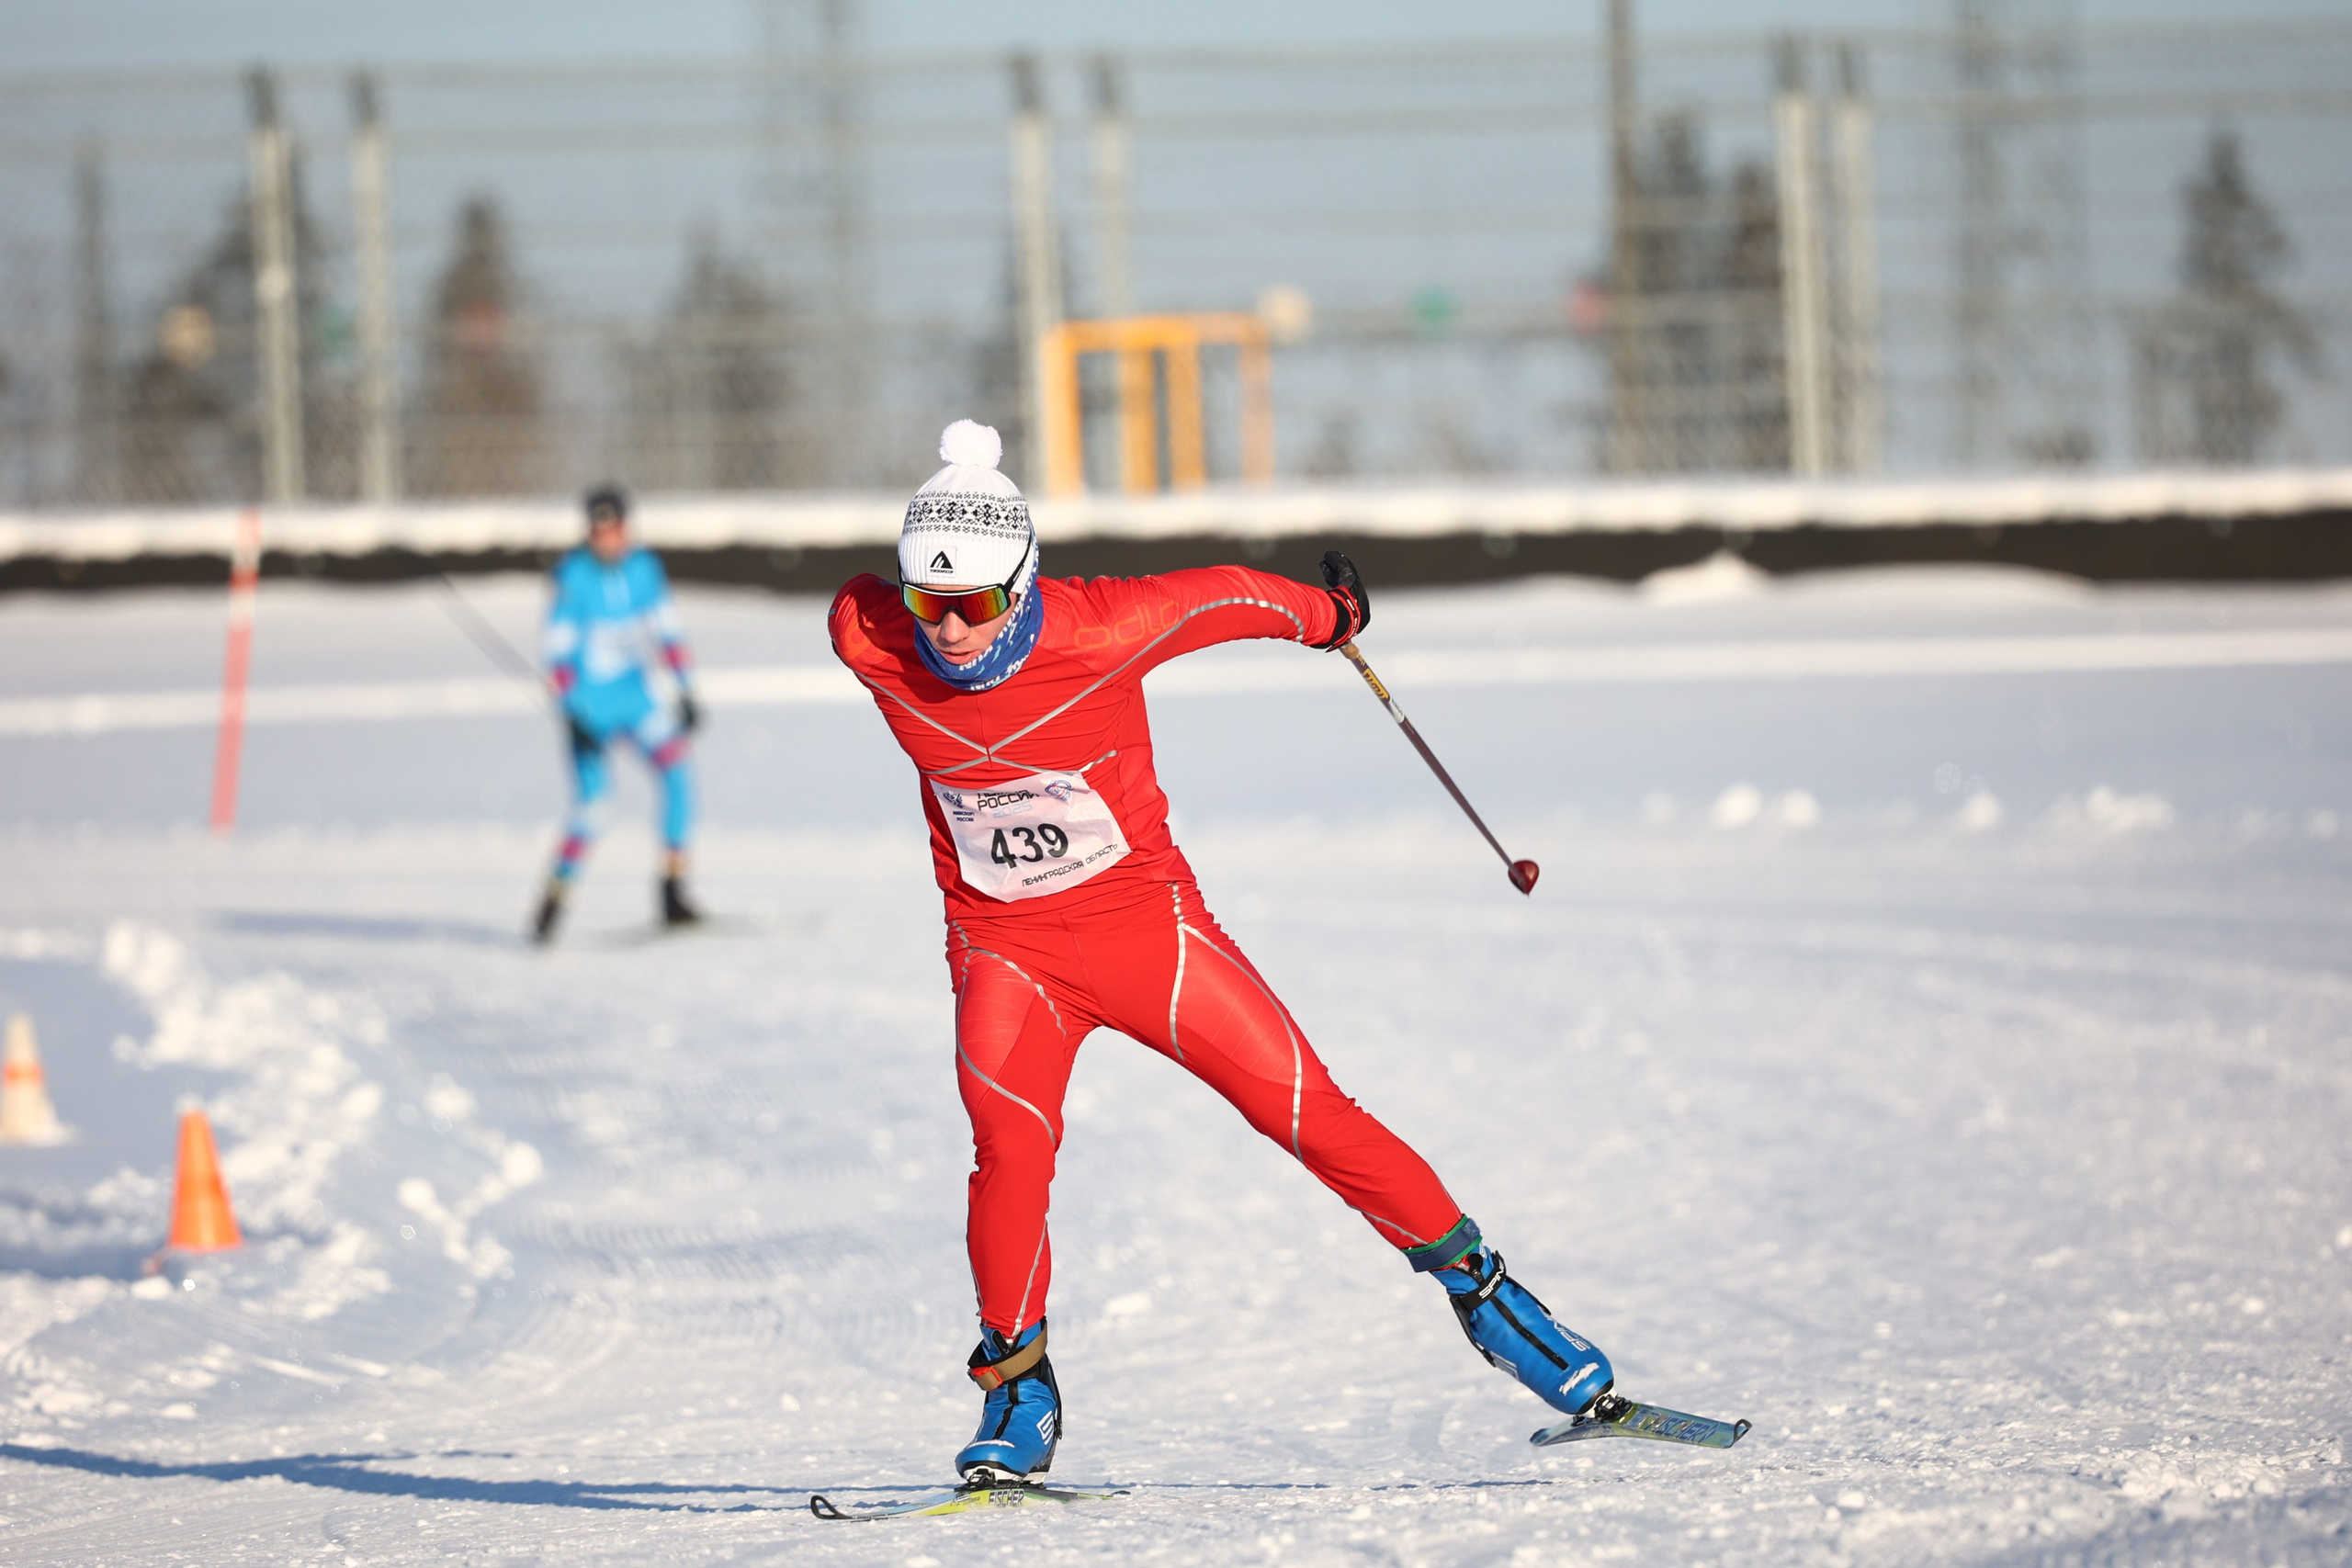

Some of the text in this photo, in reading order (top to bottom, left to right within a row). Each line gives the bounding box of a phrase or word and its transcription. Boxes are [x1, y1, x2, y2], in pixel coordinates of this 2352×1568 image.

[992, 800, 1033, 818] 2025
[990, 823, 1069, 869] 439
[1022, 843, 1118, 887] ЛЕНИНГРАДСКАЯ ОБЛАСТЬ
[989, 1489, 1025, 1508] FISCHER
